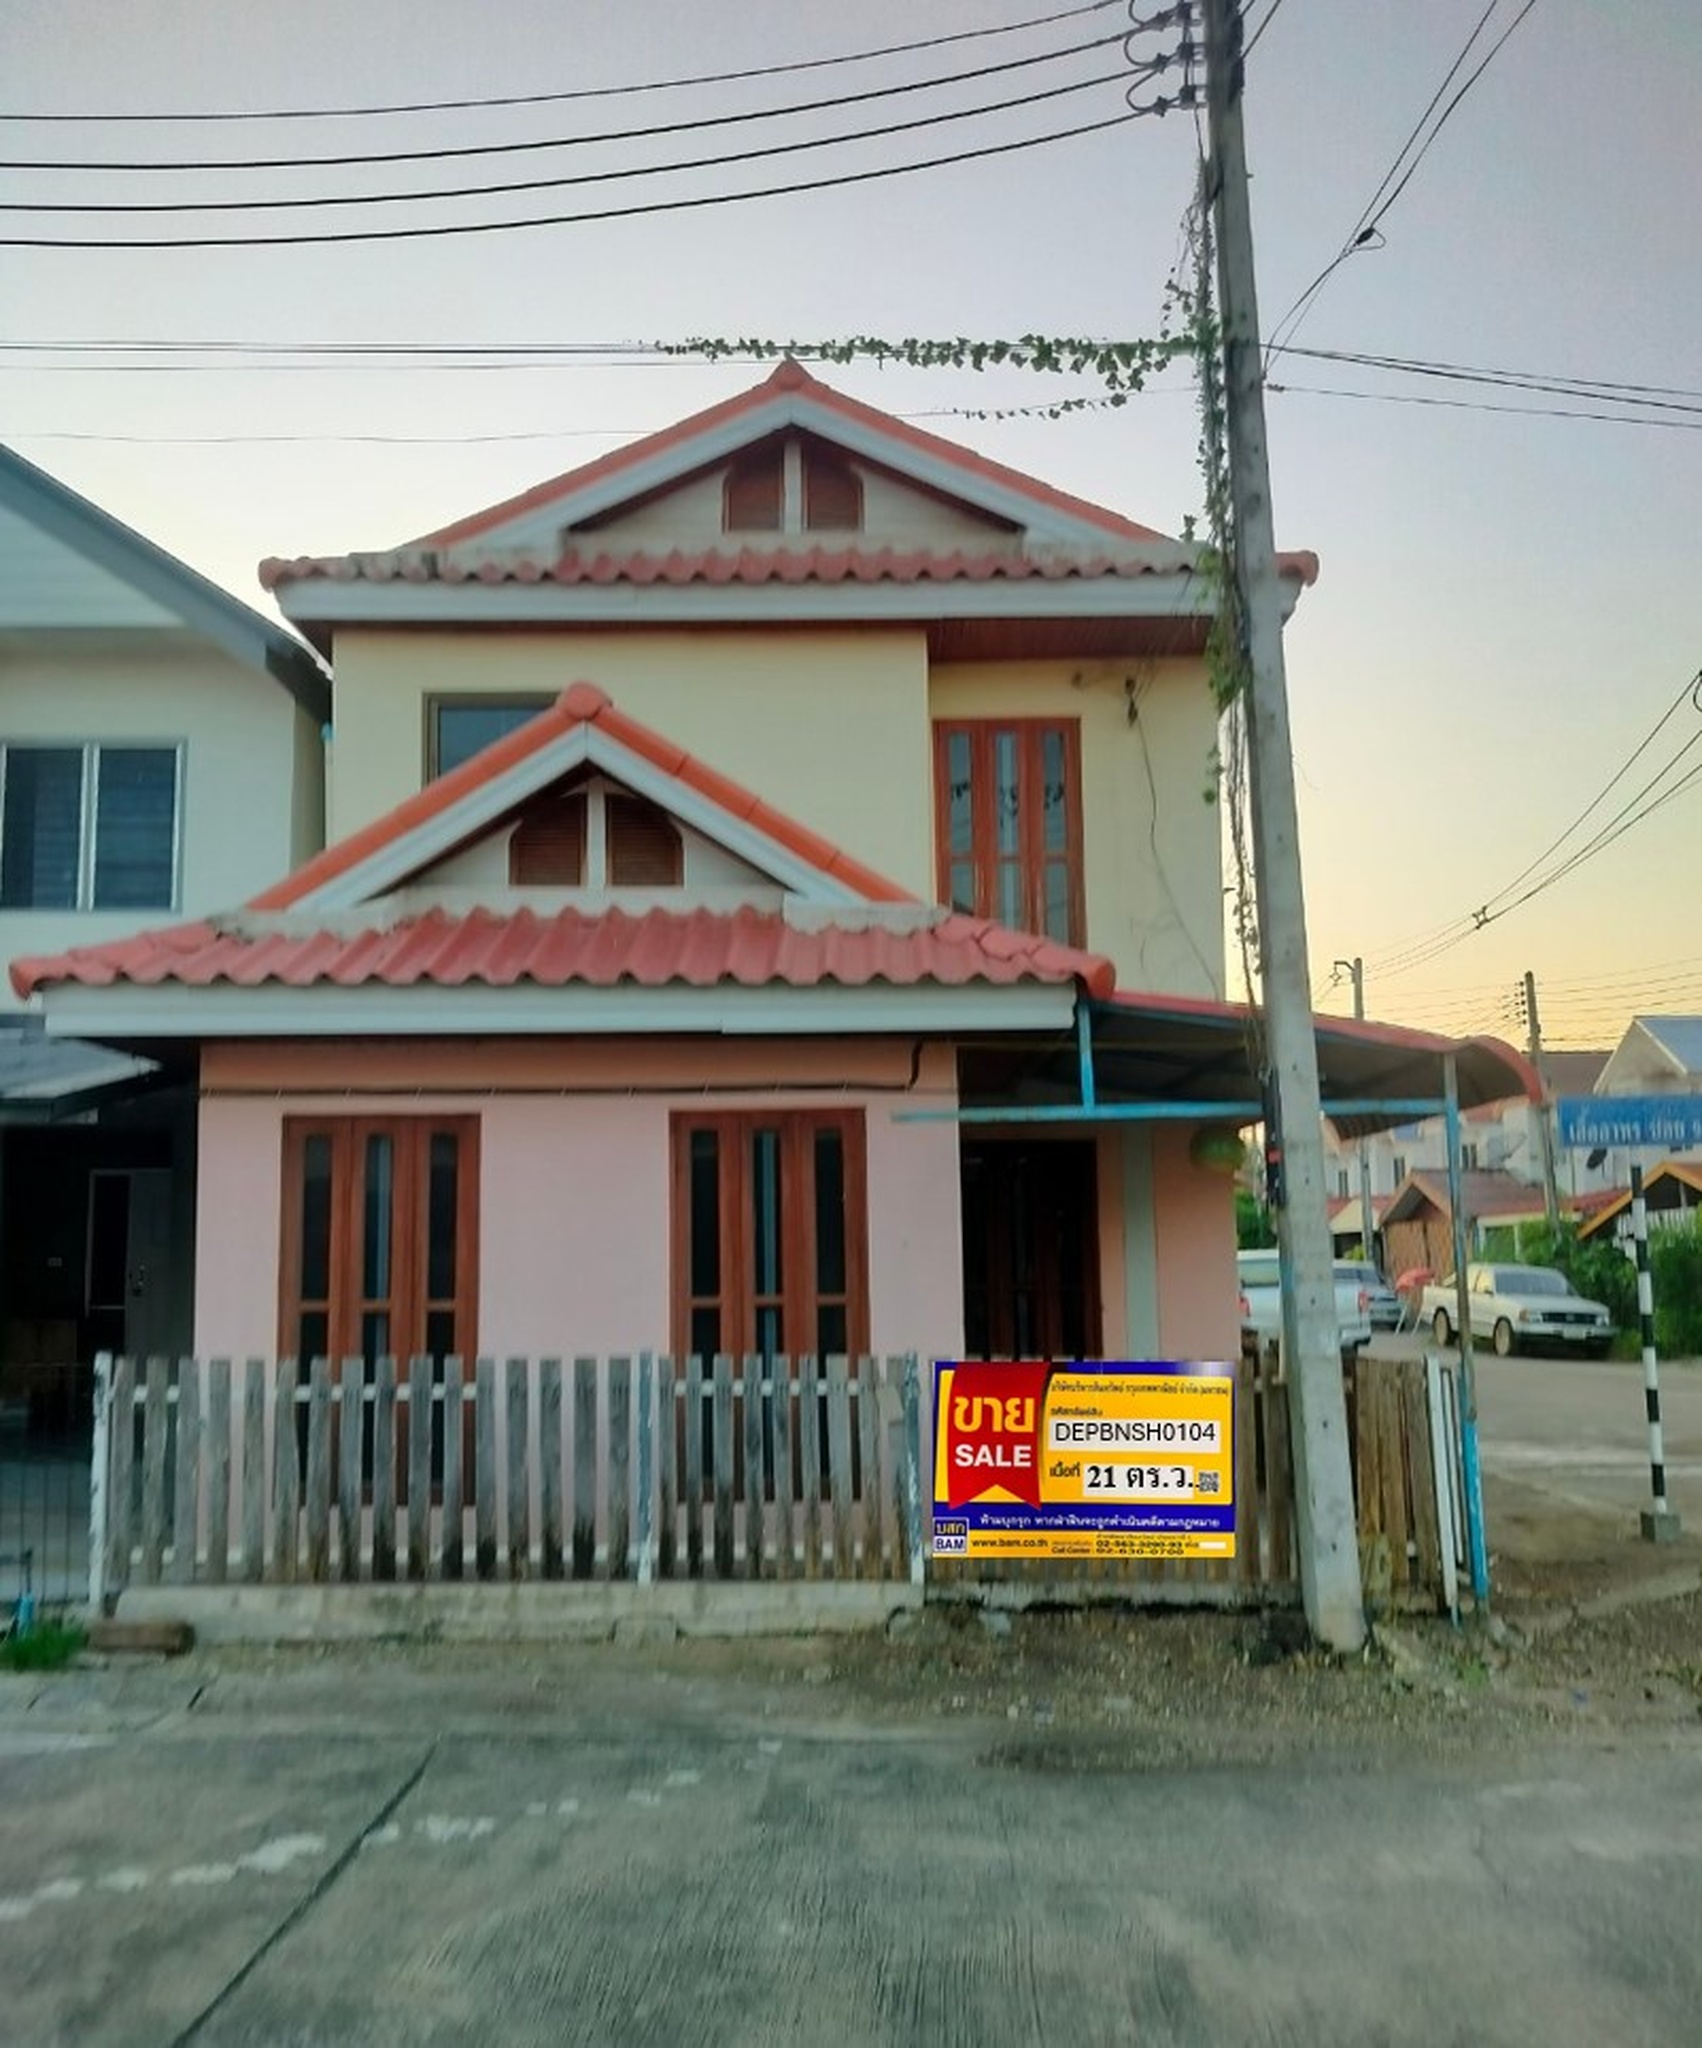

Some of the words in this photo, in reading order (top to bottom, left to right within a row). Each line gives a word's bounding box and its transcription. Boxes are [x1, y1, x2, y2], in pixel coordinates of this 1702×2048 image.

[953, 1396, 1034, 1433] ขาย
[1055, 1422, 1216, 1442] DEPBNSH0104
[955, 1444, 1032, 1468] SALE
[1087, 1465, 1117, 1488] 21
[936, 1538, 966, 1550] BAM
[971, 1538, 1049, 1548] www.bam.co.th
